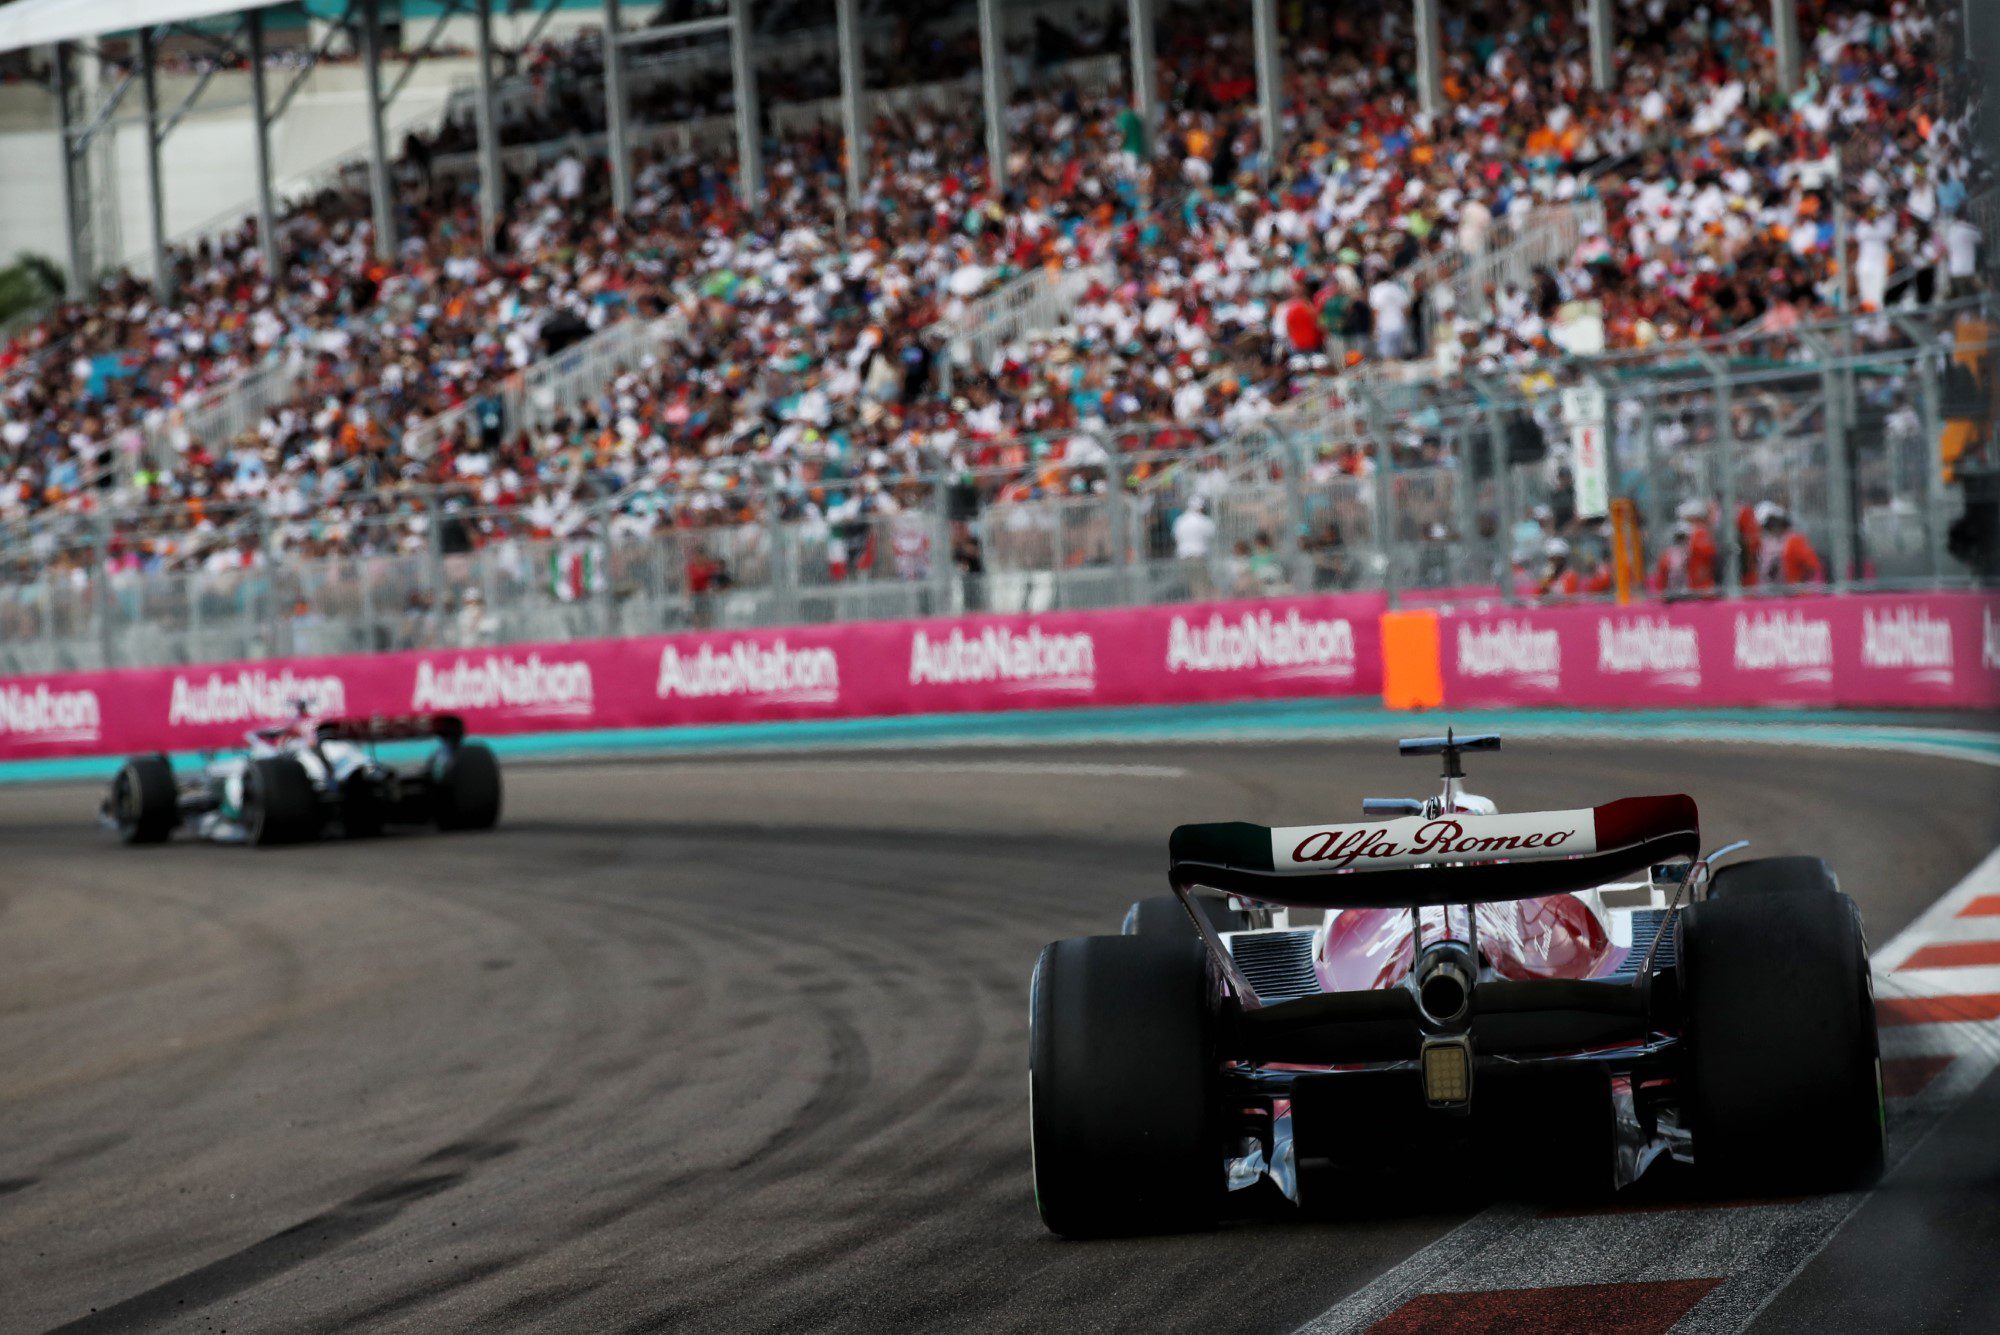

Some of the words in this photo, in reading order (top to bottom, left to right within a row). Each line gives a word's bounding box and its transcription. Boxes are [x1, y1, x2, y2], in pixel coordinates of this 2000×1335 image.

[657, 639, 839, 698] AutoNation
[909, 624, 1095, 684] AutoNation
[1167, 609, 1355, 673] AutoNation
[411, 655, 593, 709] AutoNation
[1292, 829, 1406, 871] Alfa
[1409, 820, 1575, 855] Romeo
